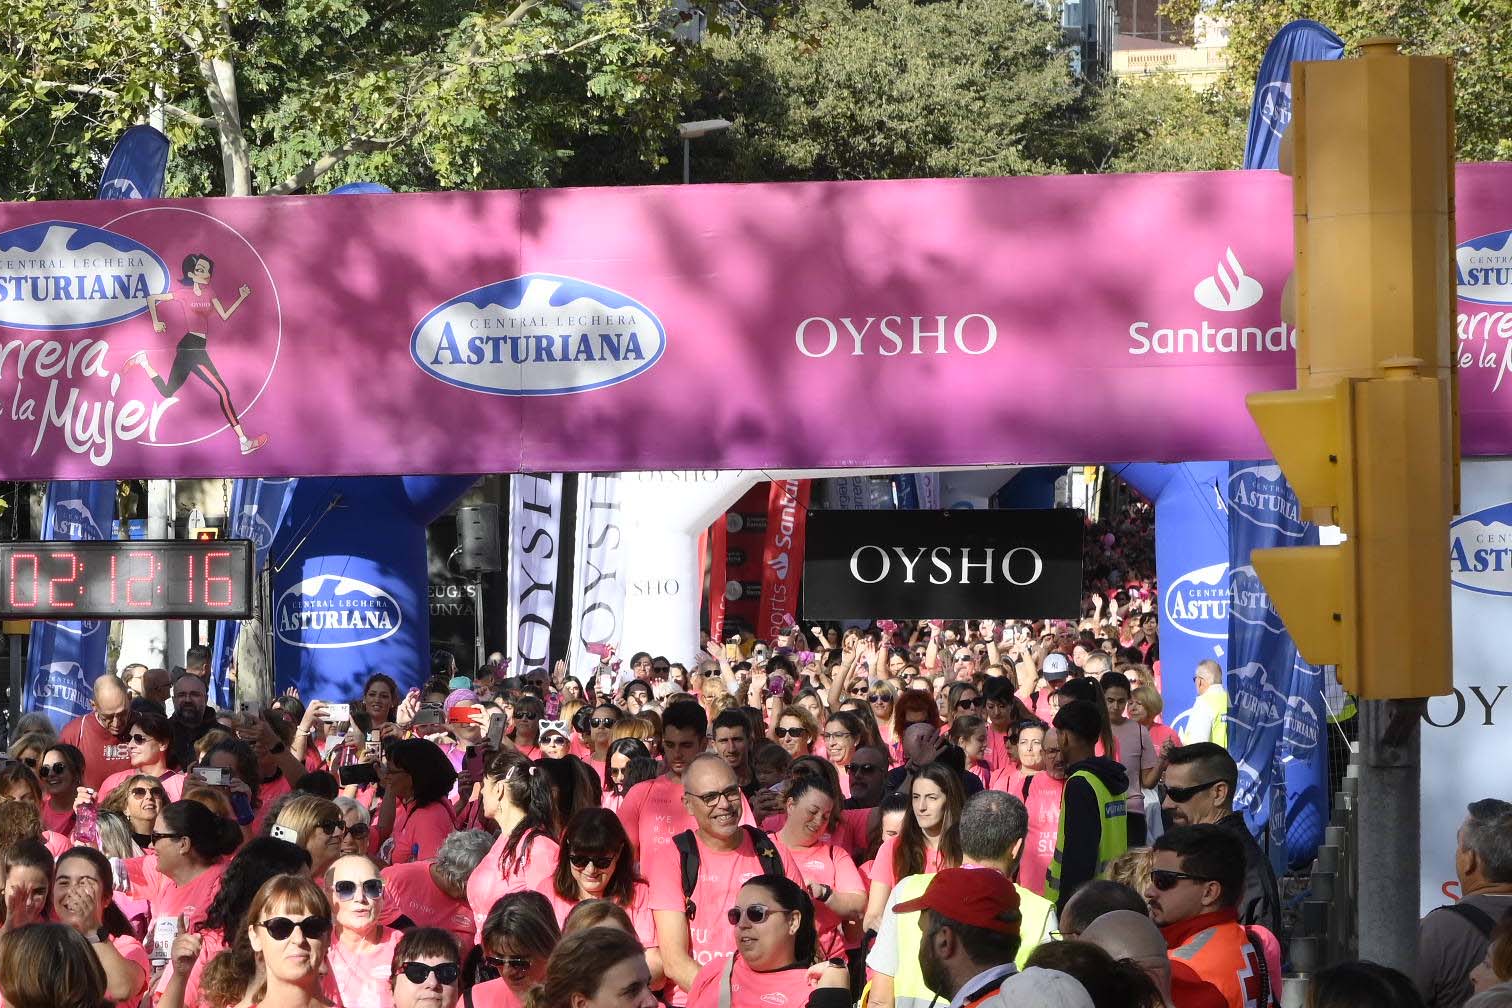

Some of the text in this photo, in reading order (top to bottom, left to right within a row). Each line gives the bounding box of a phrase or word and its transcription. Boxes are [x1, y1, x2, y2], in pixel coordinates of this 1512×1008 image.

[73, 257, 145, 269] LECHERA
[469, 313, 637, 330] CENTRAL LECHERA
[795, 313, 999, 358] OYSHO
[430, 319, 647, 366] ASTURIANA
[11, 380, 36, 421] la
[31, 373, 181, 467] Mujer
[10, 552, 233, 607] 02:12:16
[850, 545, 1043, 586] OYSHO
[279, 604, 393, 632] ASTURIANA
[1172, 588, 1230, 620] ASTU
